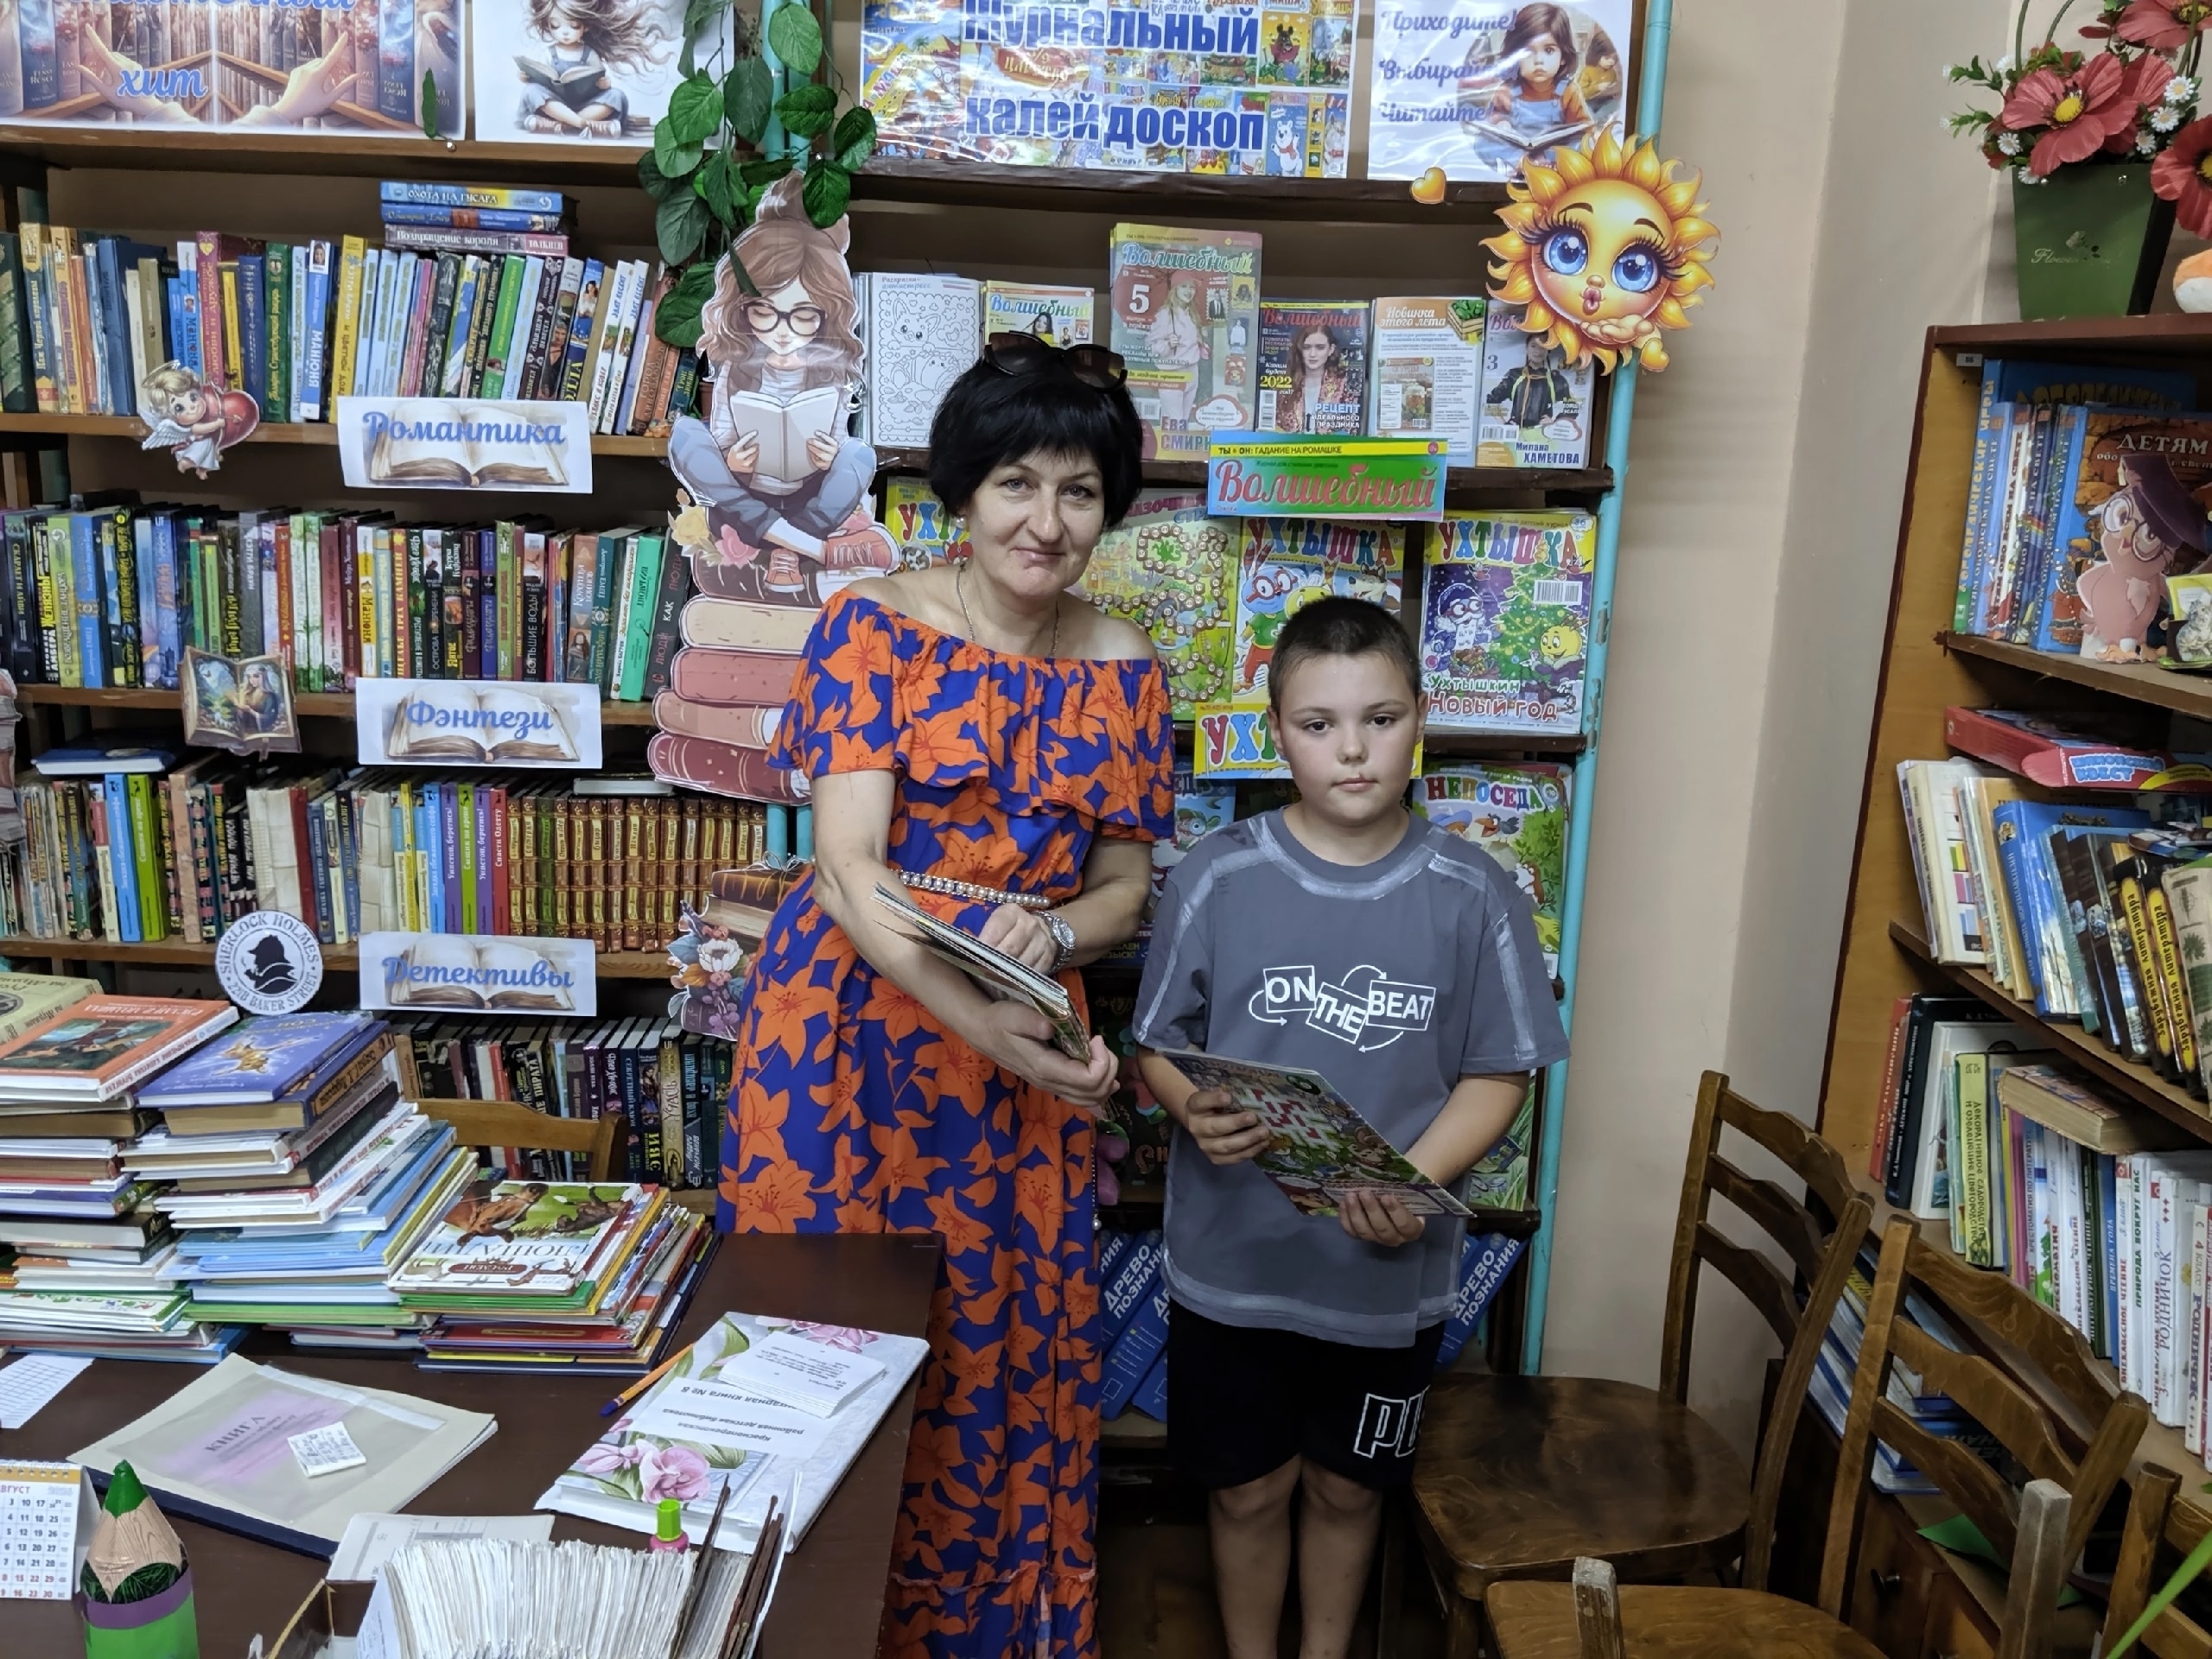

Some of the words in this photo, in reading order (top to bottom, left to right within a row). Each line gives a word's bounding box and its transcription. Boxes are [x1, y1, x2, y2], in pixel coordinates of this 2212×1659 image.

[965, 0, 1259, 55] Журнальный
[1382, 9, 1517, 39] Приходите!
[118, 68, 207, 99] хит
[1380, 102, 1495, 122] Читайте!
[408, 188, 440, 200] ОХОТА
[442, 191, 458, 201] НА
[461, 192, 499, 204] ГУСАРА
[397, 229, 461, 246] Возвращение
[464, 232, 499, 246] короля
[1122, 243, 1253, 275] Волшебный
[990, 295, 1091, 317] Волшебный
[1128, 283, 1150, 314] 5
[1385, 306, 1435, 320] Новинка
[1263, 308, 1363, 327] Волшебный
[1380, 317, 1413, 328] этого
[1414, 317, 1446, 327] лета
[308, 330, 322, 387] МАНЮНЯ
[1486, 354, 1498, 371] 3
[1259, 375, 1293, 389] 2022
[1314, 403, 1361, 414] РЕЦЕПТ
[1980, 380, 1994, 430] ИГРЫ
[362, 411, 566, 444] Романтика
[1161, 416, 1187, 431] Ева
[1516, 442, 1549, 452] Милана
[1523, 453, 1580, 464] ХАМЕТОВА
[2116, 433, 2209, 454] ДЕТЯМ
[1215, 459, 1437, 508] Волшебный
[1251, 518, 1396, 567] УХТЫШКА
[1438, 520, 1579, 569] УХТЫШКА
[394, 552, 404, 601] КАМНЕЙ
[663, 601, 674, 621] КАК
[669, 554, 682, 590] ЛЮДИ
[525, 594, 537, 623] ВОДЫ
[48, 629, 58, 671] АМБЕРА
[431, 636, 440, 670] ОСТРОВА
[526, 625, 537, 674] БОЛЬШИЕ
[406, 701, 554, 741] Фэнтези
[1425, 776, 1544, 811] НЕПОСЕДА
[428, 805, 437, 826] сейфа
[446, 807, 455, 843] берегись!
[477, 808, 486, 844] берегись!
[494, 809, 505, 837] Одетту
[447, 845, 456, 879] Уинстон,
[479, 847, 487, 880] Уинстон,
[495, 839, 504, 867] Спасти
[219, 913, 269, 974] SHERLOCK
[272, 913, 320, 963] HOLMES
[2127, 893, 2150, 966] литература
[2152, 905, 2177, 978] литература
[382, 957, 575, 988] Детективы
[249, 995, 285, 1012] BAKER
[287, 971, 318, 1007] STREET
[1266, 976, 1316, 1004] ON
[1314, 993, 1366, 1036] THE
[1368, 989, 1434, 1021] BEAT
[2144, 969, 2168, 1039] Зарубежная
[2170, 982, 2191, 1054] Зарубежная
[2026, 1180, 2033, 1192] ПО
[2025, 1195, 2035, 1254] ХРЕСТОМАТИЯ
[1104, 1245, 1150, 1312] ДРЕВО
[1454, 1249, 1496, 1318] ДРЕВО
[1459, 1238, 1521, 1327] ПОЗНАНИЯ
[2051, 1224, 2061, 1312] РЕСТОМАТИЯ
[2108, 1248, 2117, 1292] ВРЕМЕНА
[2159, 1249, 2171, 1350] РОДНИЧОК
[2189, 1293, 2202, 1401] РОДНИЧОК
[692, 1387, 706, 1397] №
[709, 1390, 742, 1402] книга
[663, 1408, 718, 1422] библиотека
[718, 1418, 758, 1428] детская
[758, 1423, 804, 1435] районная
[206, 1415, 265, 1452] КНИГА
[43, 1590, 53, 1599] 30
